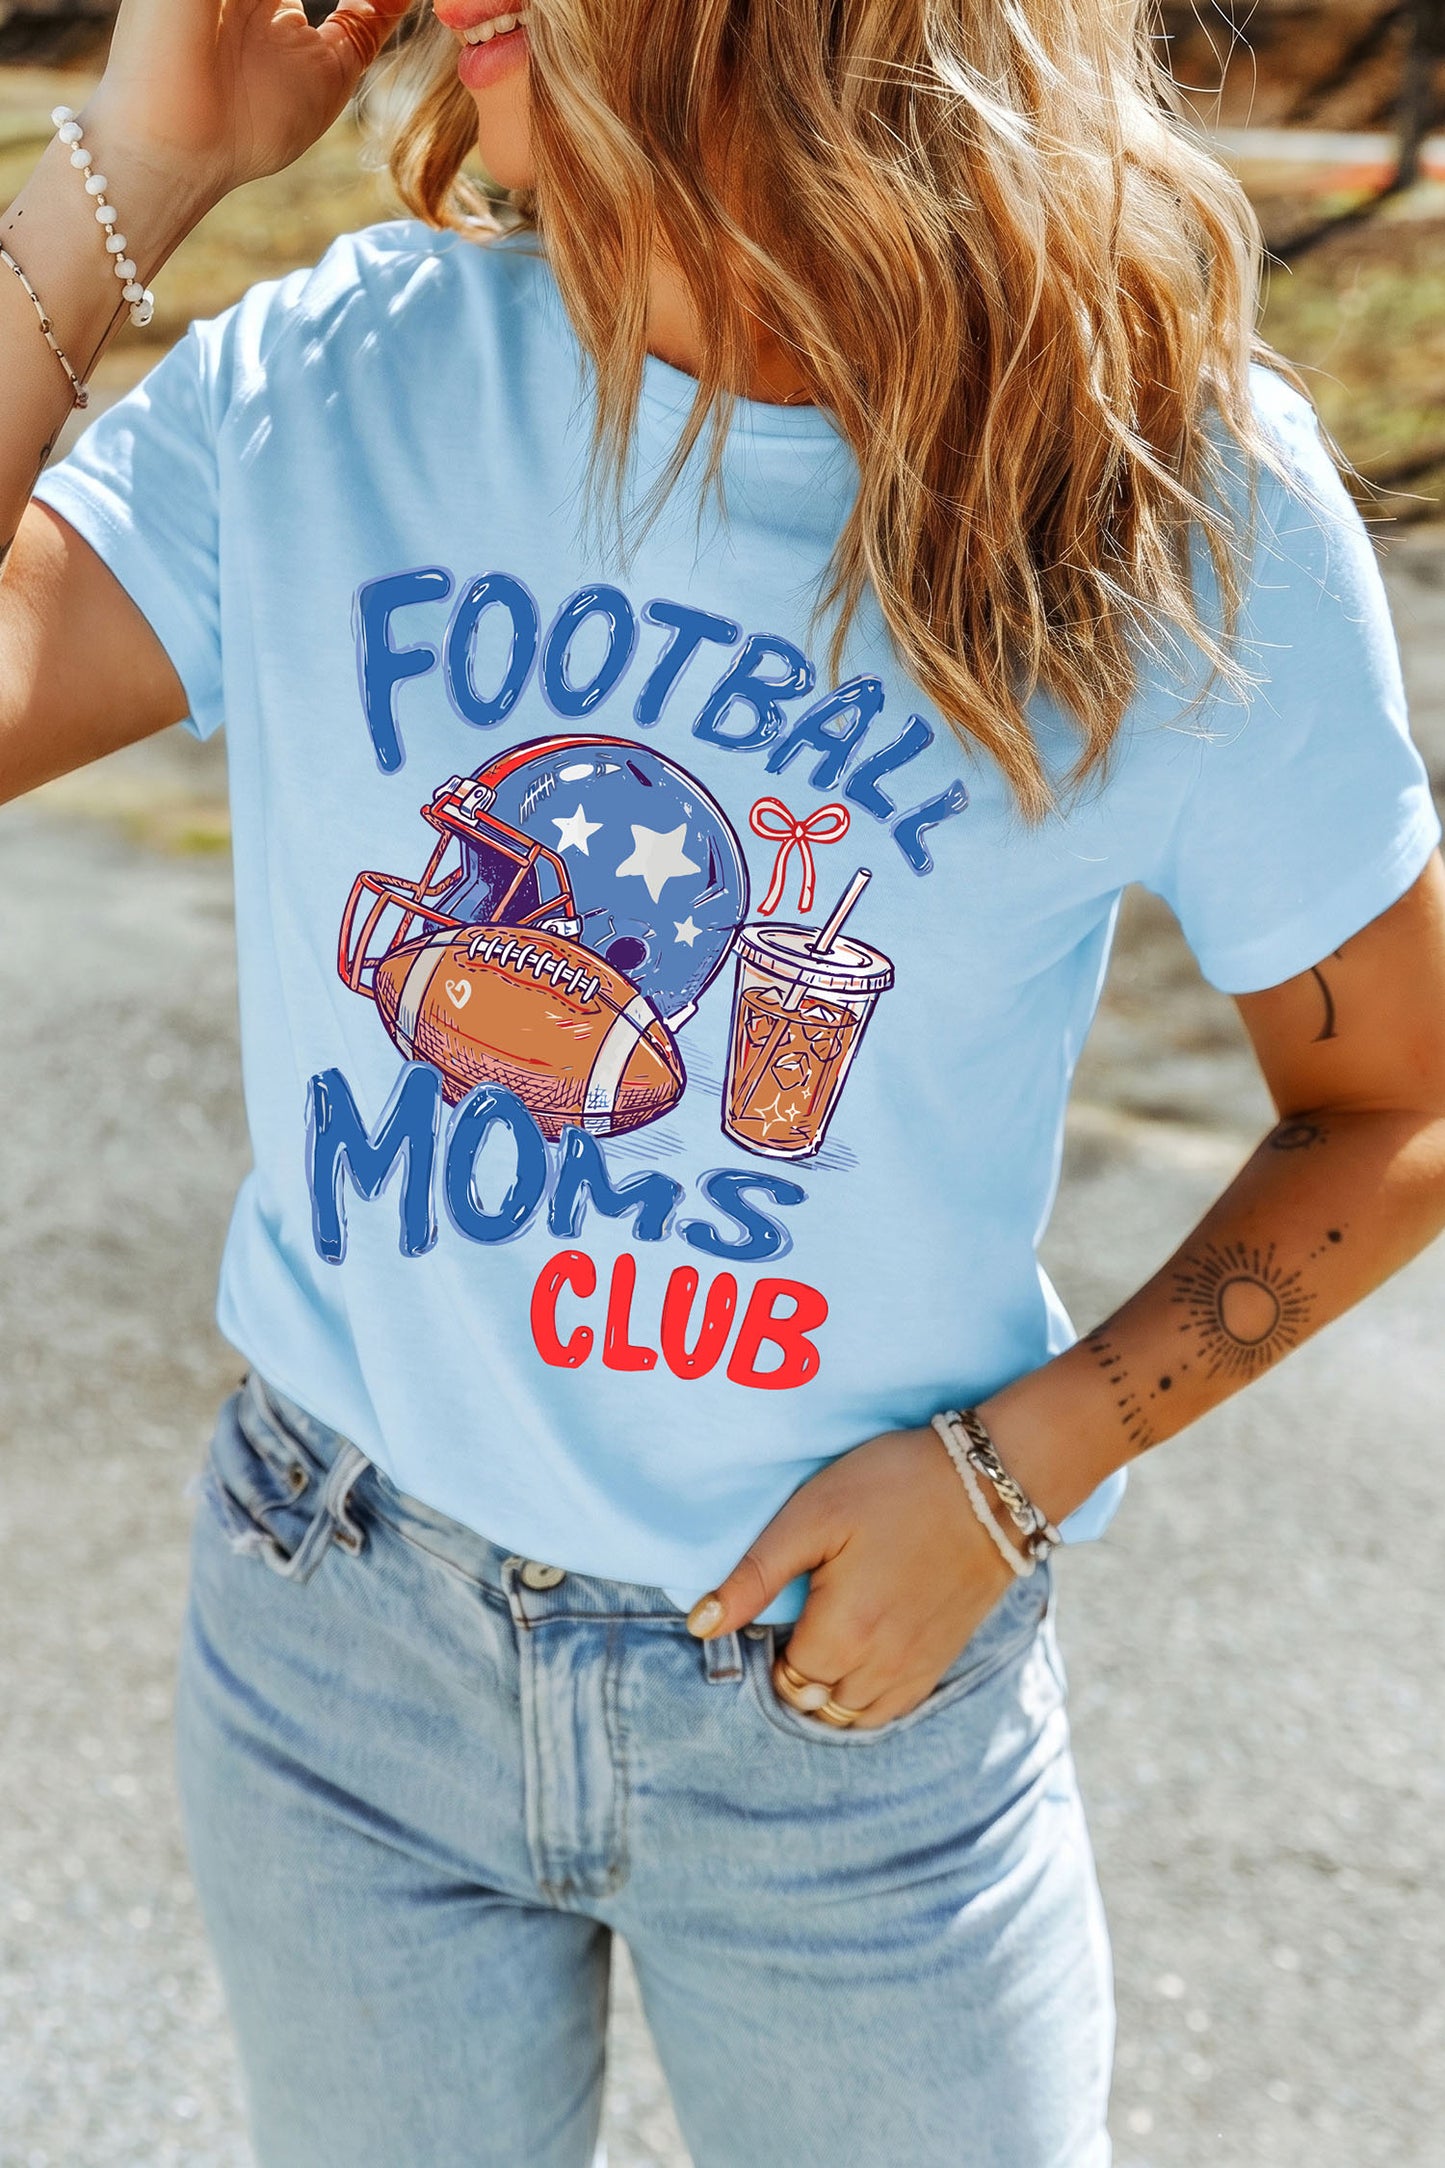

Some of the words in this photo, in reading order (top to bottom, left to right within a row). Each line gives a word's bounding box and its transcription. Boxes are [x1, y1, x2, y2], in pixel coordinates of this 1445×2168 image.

[355, 567, 969, 876] FOOTBALL
[306, 1061, 808, 1265] MOMS
[530, 1250, 829, 1390] CLUB
